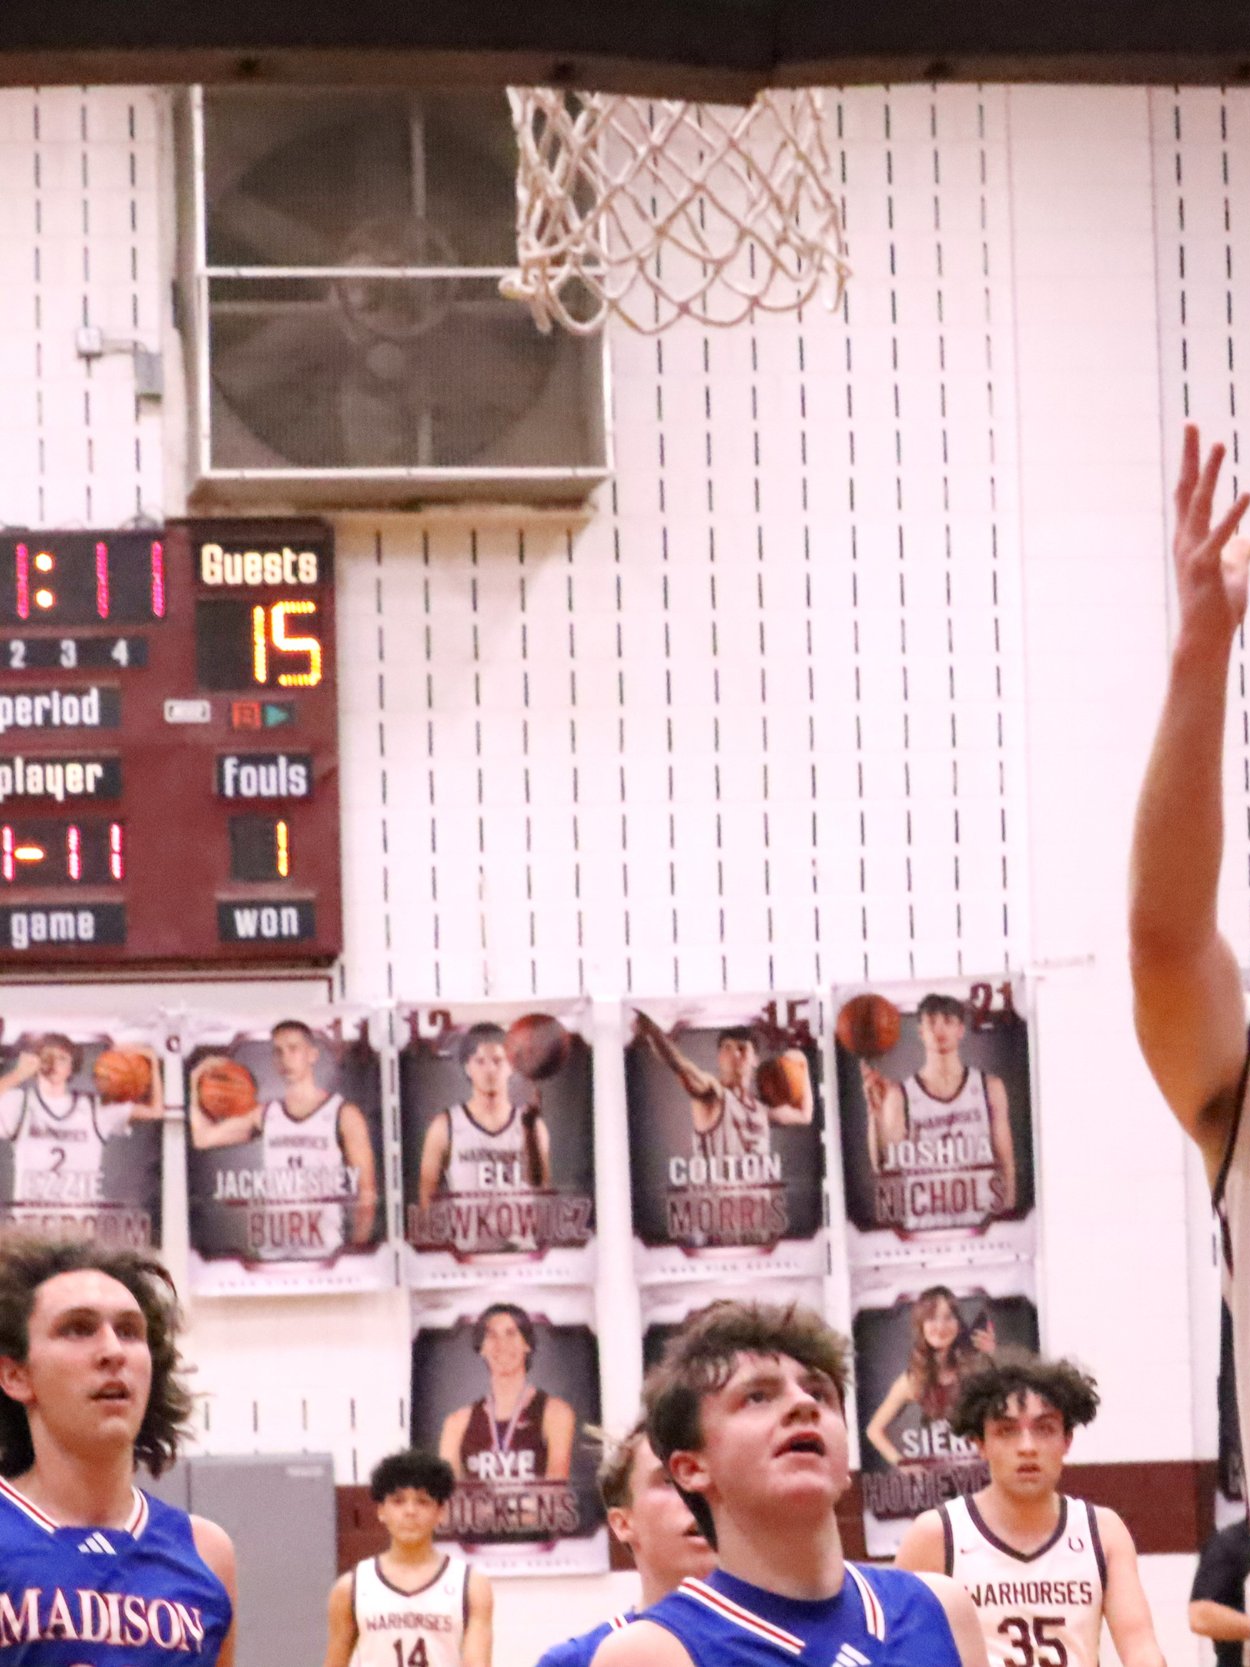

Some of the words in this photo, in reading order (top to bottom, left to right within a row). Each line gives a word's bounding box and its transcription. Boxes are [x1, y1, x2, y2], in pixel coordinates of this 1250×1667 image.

[201, 544, 318, 585] Guests
[9, 639, 26, 669] 2
[60, 639, 78, 669] 3
[111, 639, 129, 668] 4
[251, 600, 322, 687] 15
[0, 686, 100, 734] period
[0, 755, 103, 803] player
[275, 820, 290, 877] 1
[10, 911, 94, 950] game
[233, 906, 299, 938] won
[668, 1152, 782, 1186] COLTON
[883, 1134, 995, 1170] JOSHUA
[668, 1193, 790, 1237] MORRIS
[876, 1174, 1007, 1219] NICHOLS
[250, 1210, 326, 1248] BURK
[0, 1586, 205, 1653] MADISON
[997, 1616, 1068, 1667] 35
